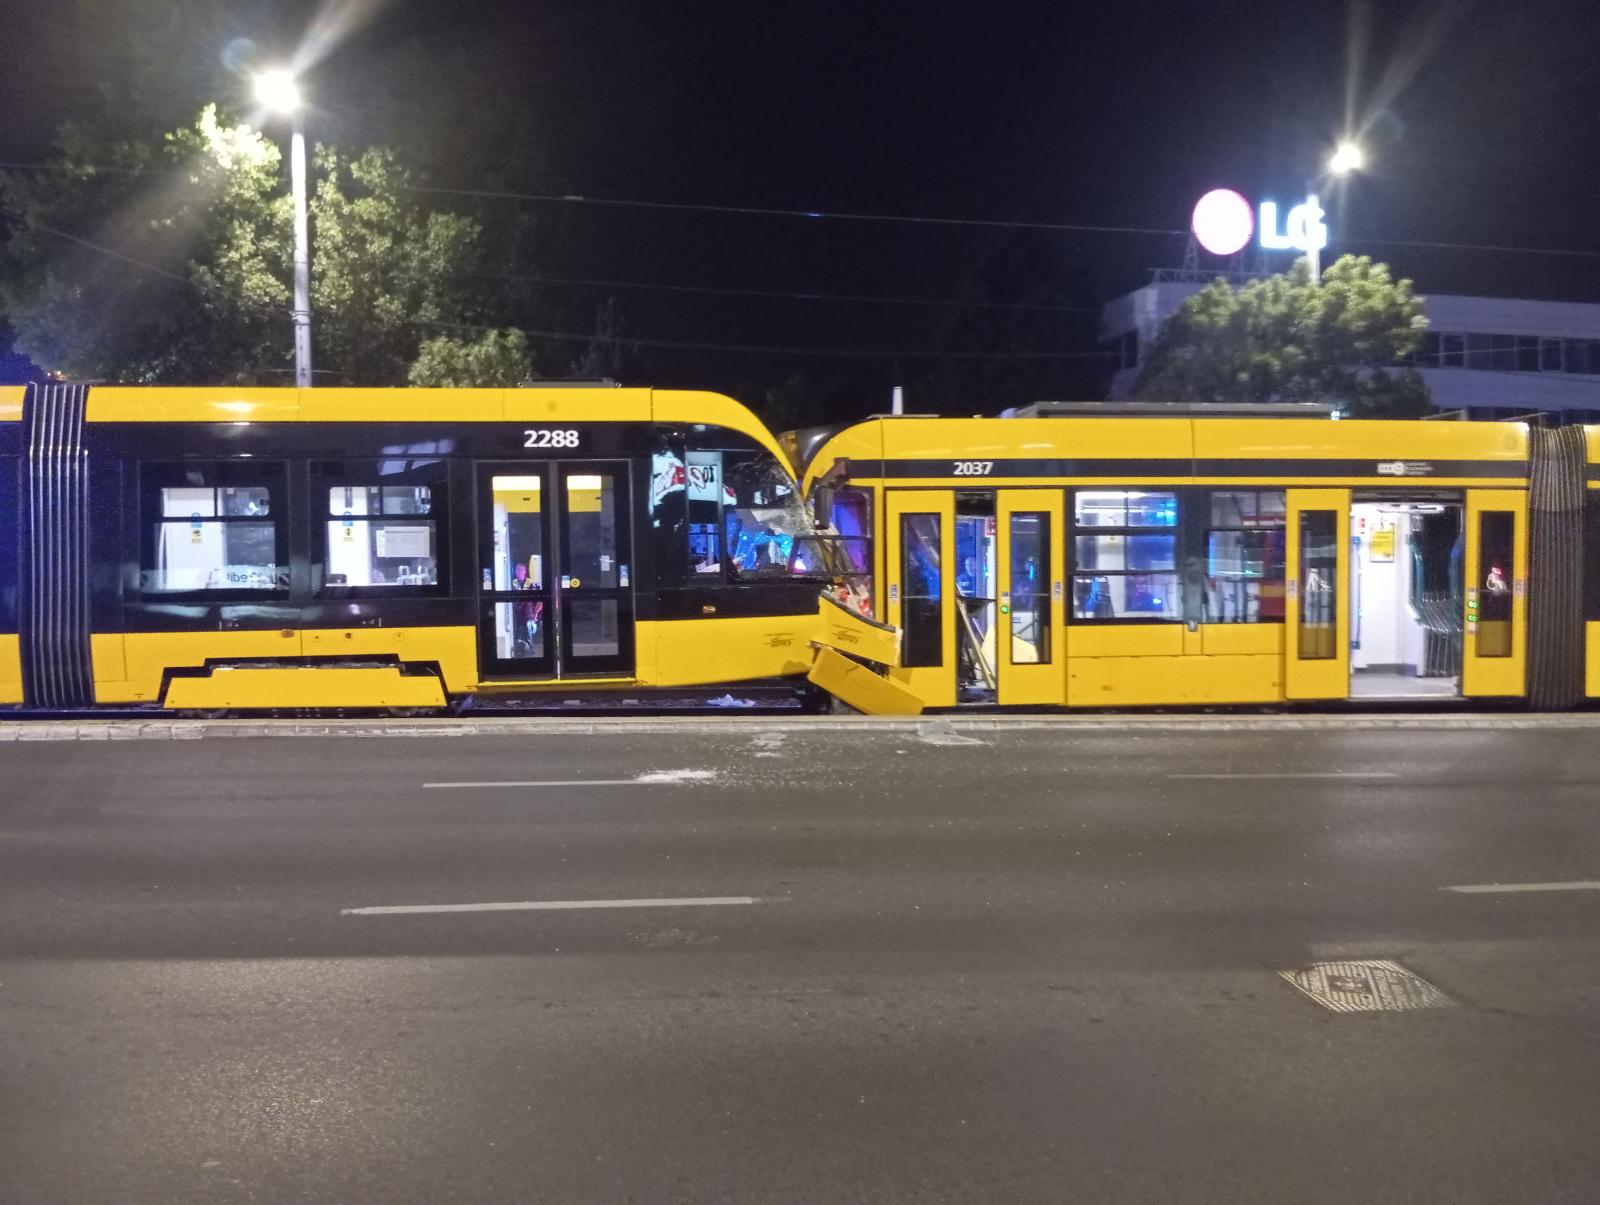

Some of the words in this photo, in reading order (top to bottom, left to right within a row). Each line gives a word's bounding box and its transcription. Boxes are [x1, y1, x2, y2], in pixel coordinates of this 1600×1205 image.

[1260, 201, 1327, 251] LG
[524, 430, 580, 448] 2288
[953, 461, 994, 475] 2037
